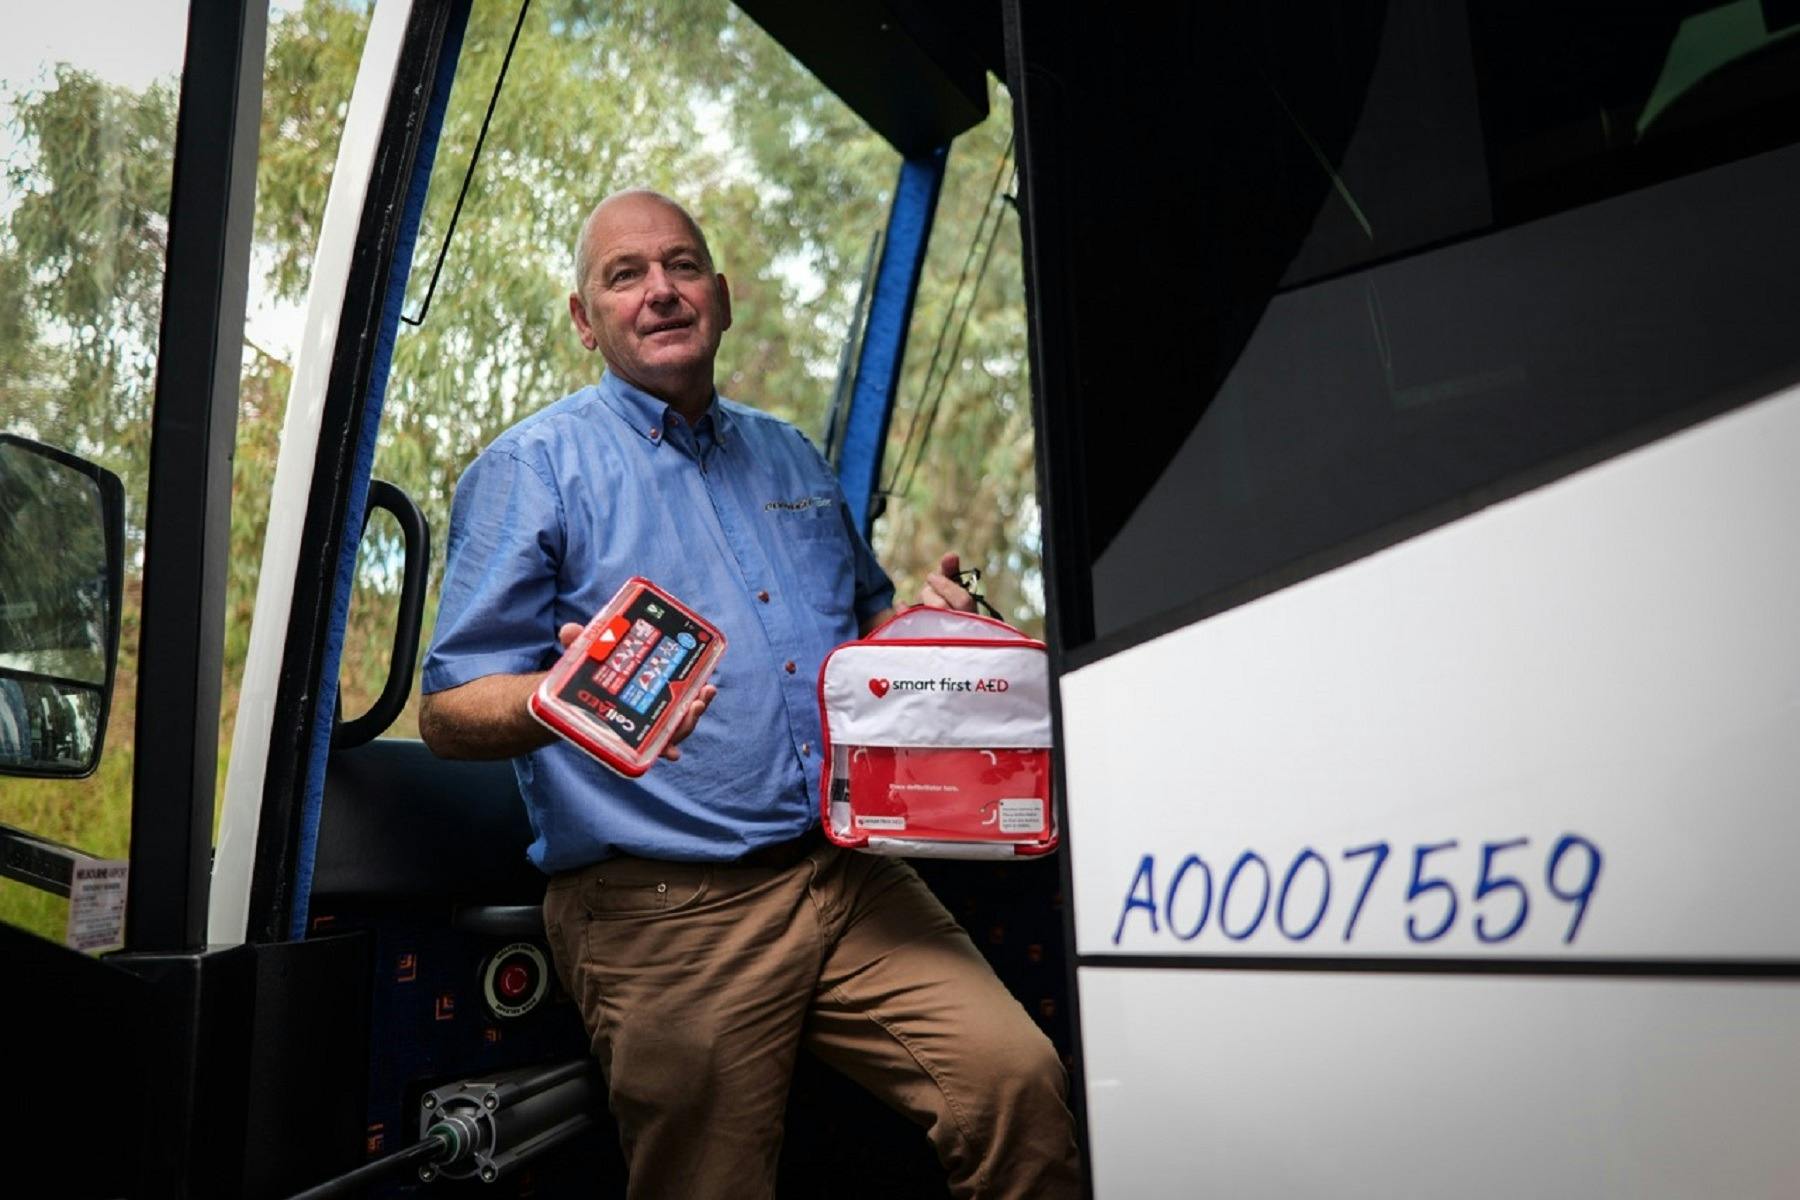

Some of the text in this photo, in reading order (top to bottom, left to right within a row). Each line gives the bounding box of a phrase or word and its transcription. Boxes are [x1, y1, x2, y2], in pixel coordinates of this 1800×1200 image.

[892, 678, 1009, 692] smart first AED
[1113, 832, 1603, 946] A0007559
